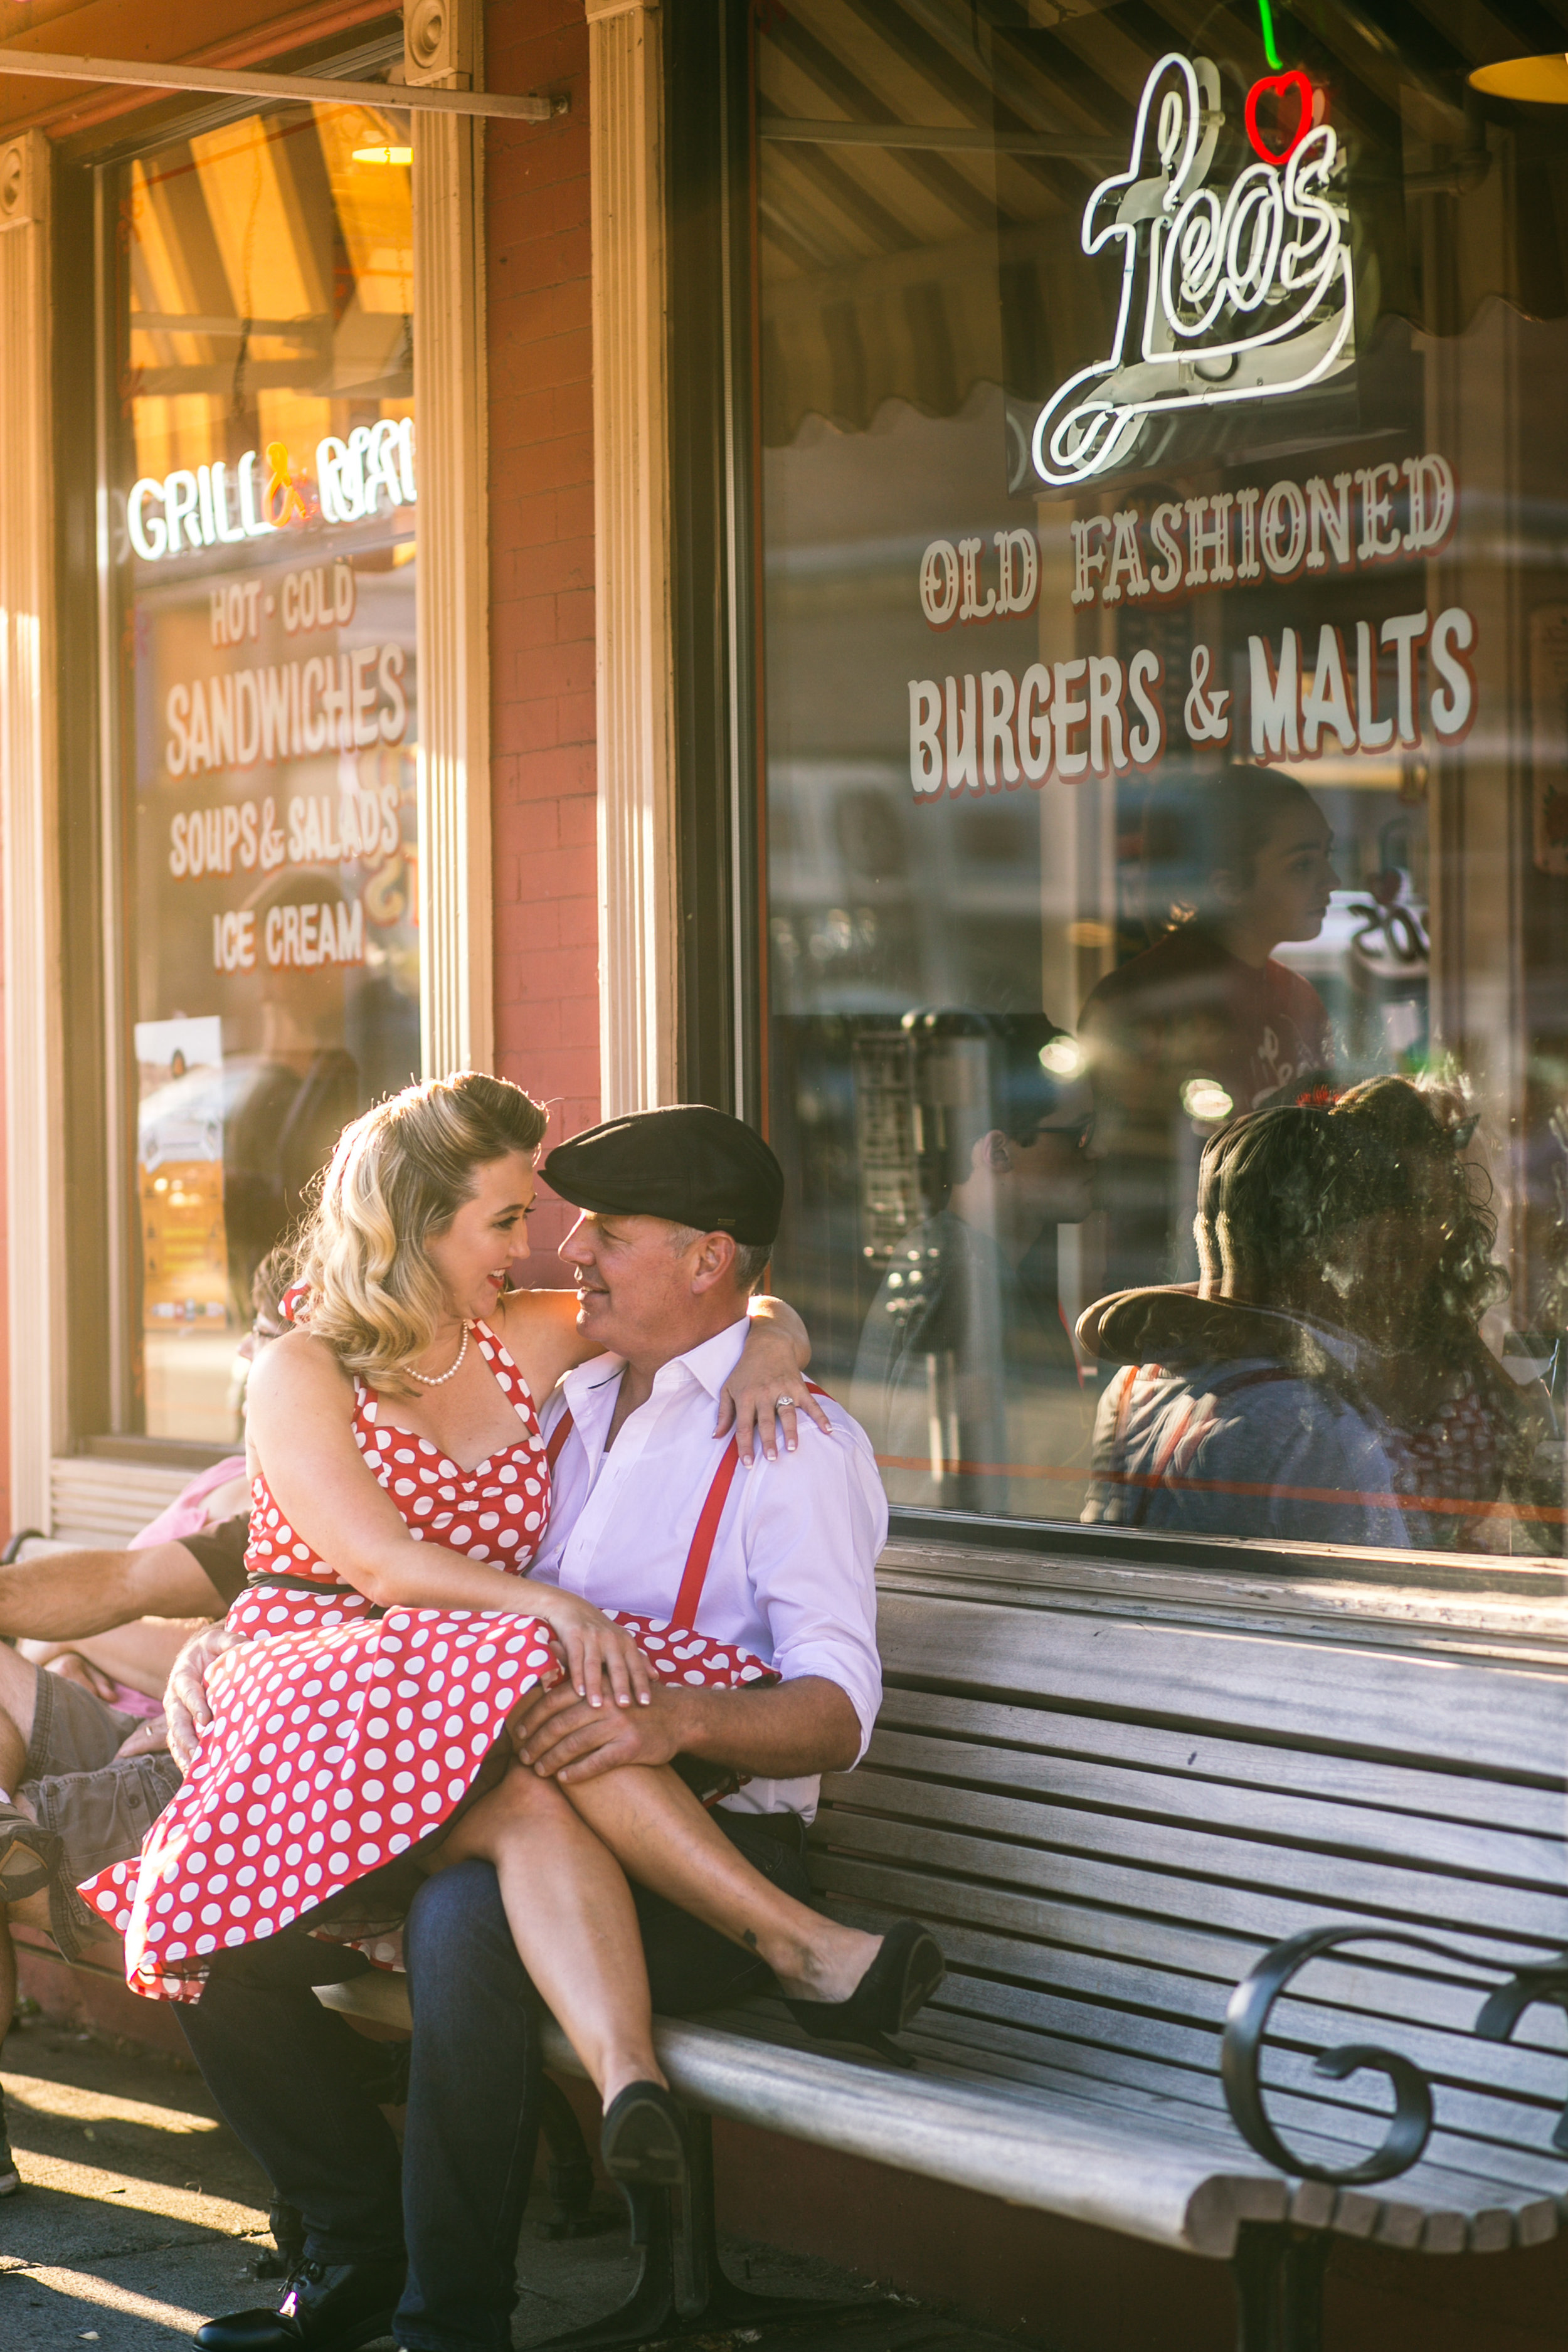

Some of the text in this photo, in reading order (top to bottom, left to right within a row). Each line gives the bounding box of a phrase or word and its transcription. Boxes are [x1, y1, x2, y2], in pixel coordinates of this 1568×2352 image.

[127, 450, 278, 561] GRILL
[261, 442, 310, 528] &
[919, 453, 1461, 630] OLD FASHIONED
[210, 564, 356, 649] HOT COLD
[165, 642, 407, 781] SANDWICHES
[908, 606, 1479, 805] BURGERS & MALTS
[169, 801, 258, 882] SOUPS
[260, 797, 286, 878] &
[288, 783, 402, 865] SALADS
[213, 898, 366, 975] ICE CREAM
